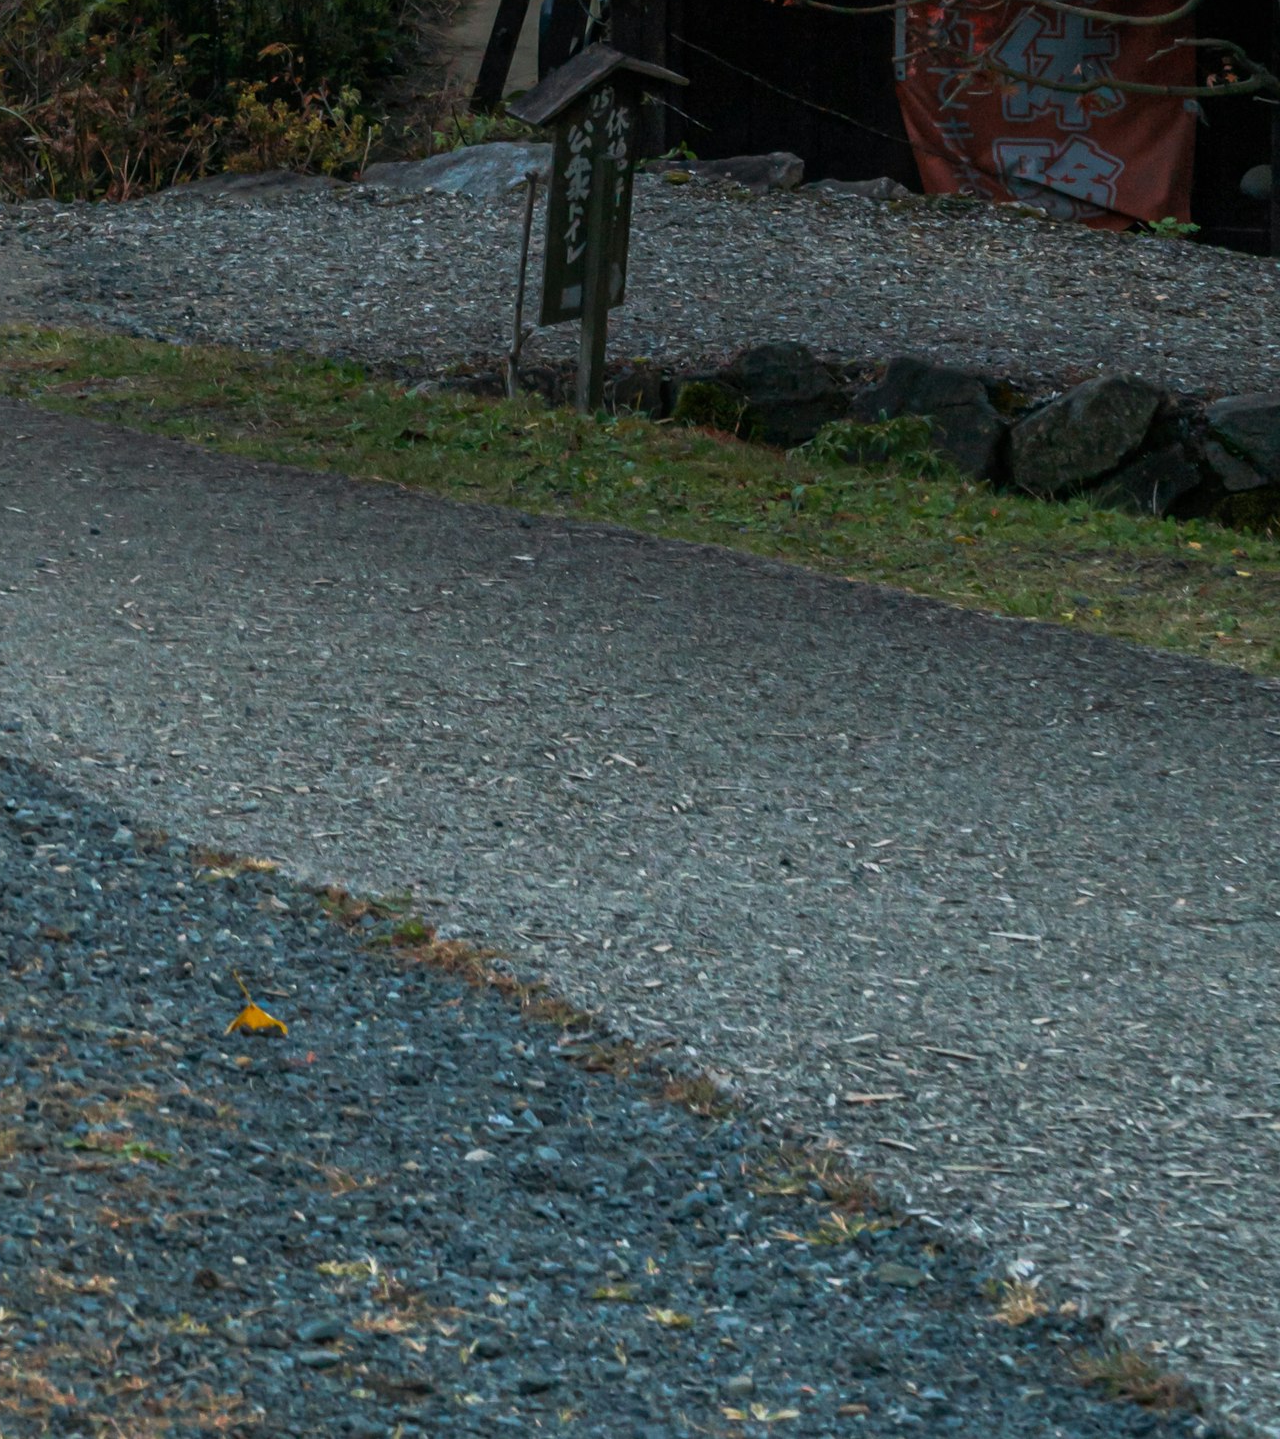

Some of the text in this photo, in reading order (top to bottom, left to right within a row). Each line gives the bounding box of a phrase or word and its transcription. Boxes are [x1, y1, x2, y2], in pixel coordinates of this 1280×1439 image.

[563, 119, 594, 265] 公衆トイレ
